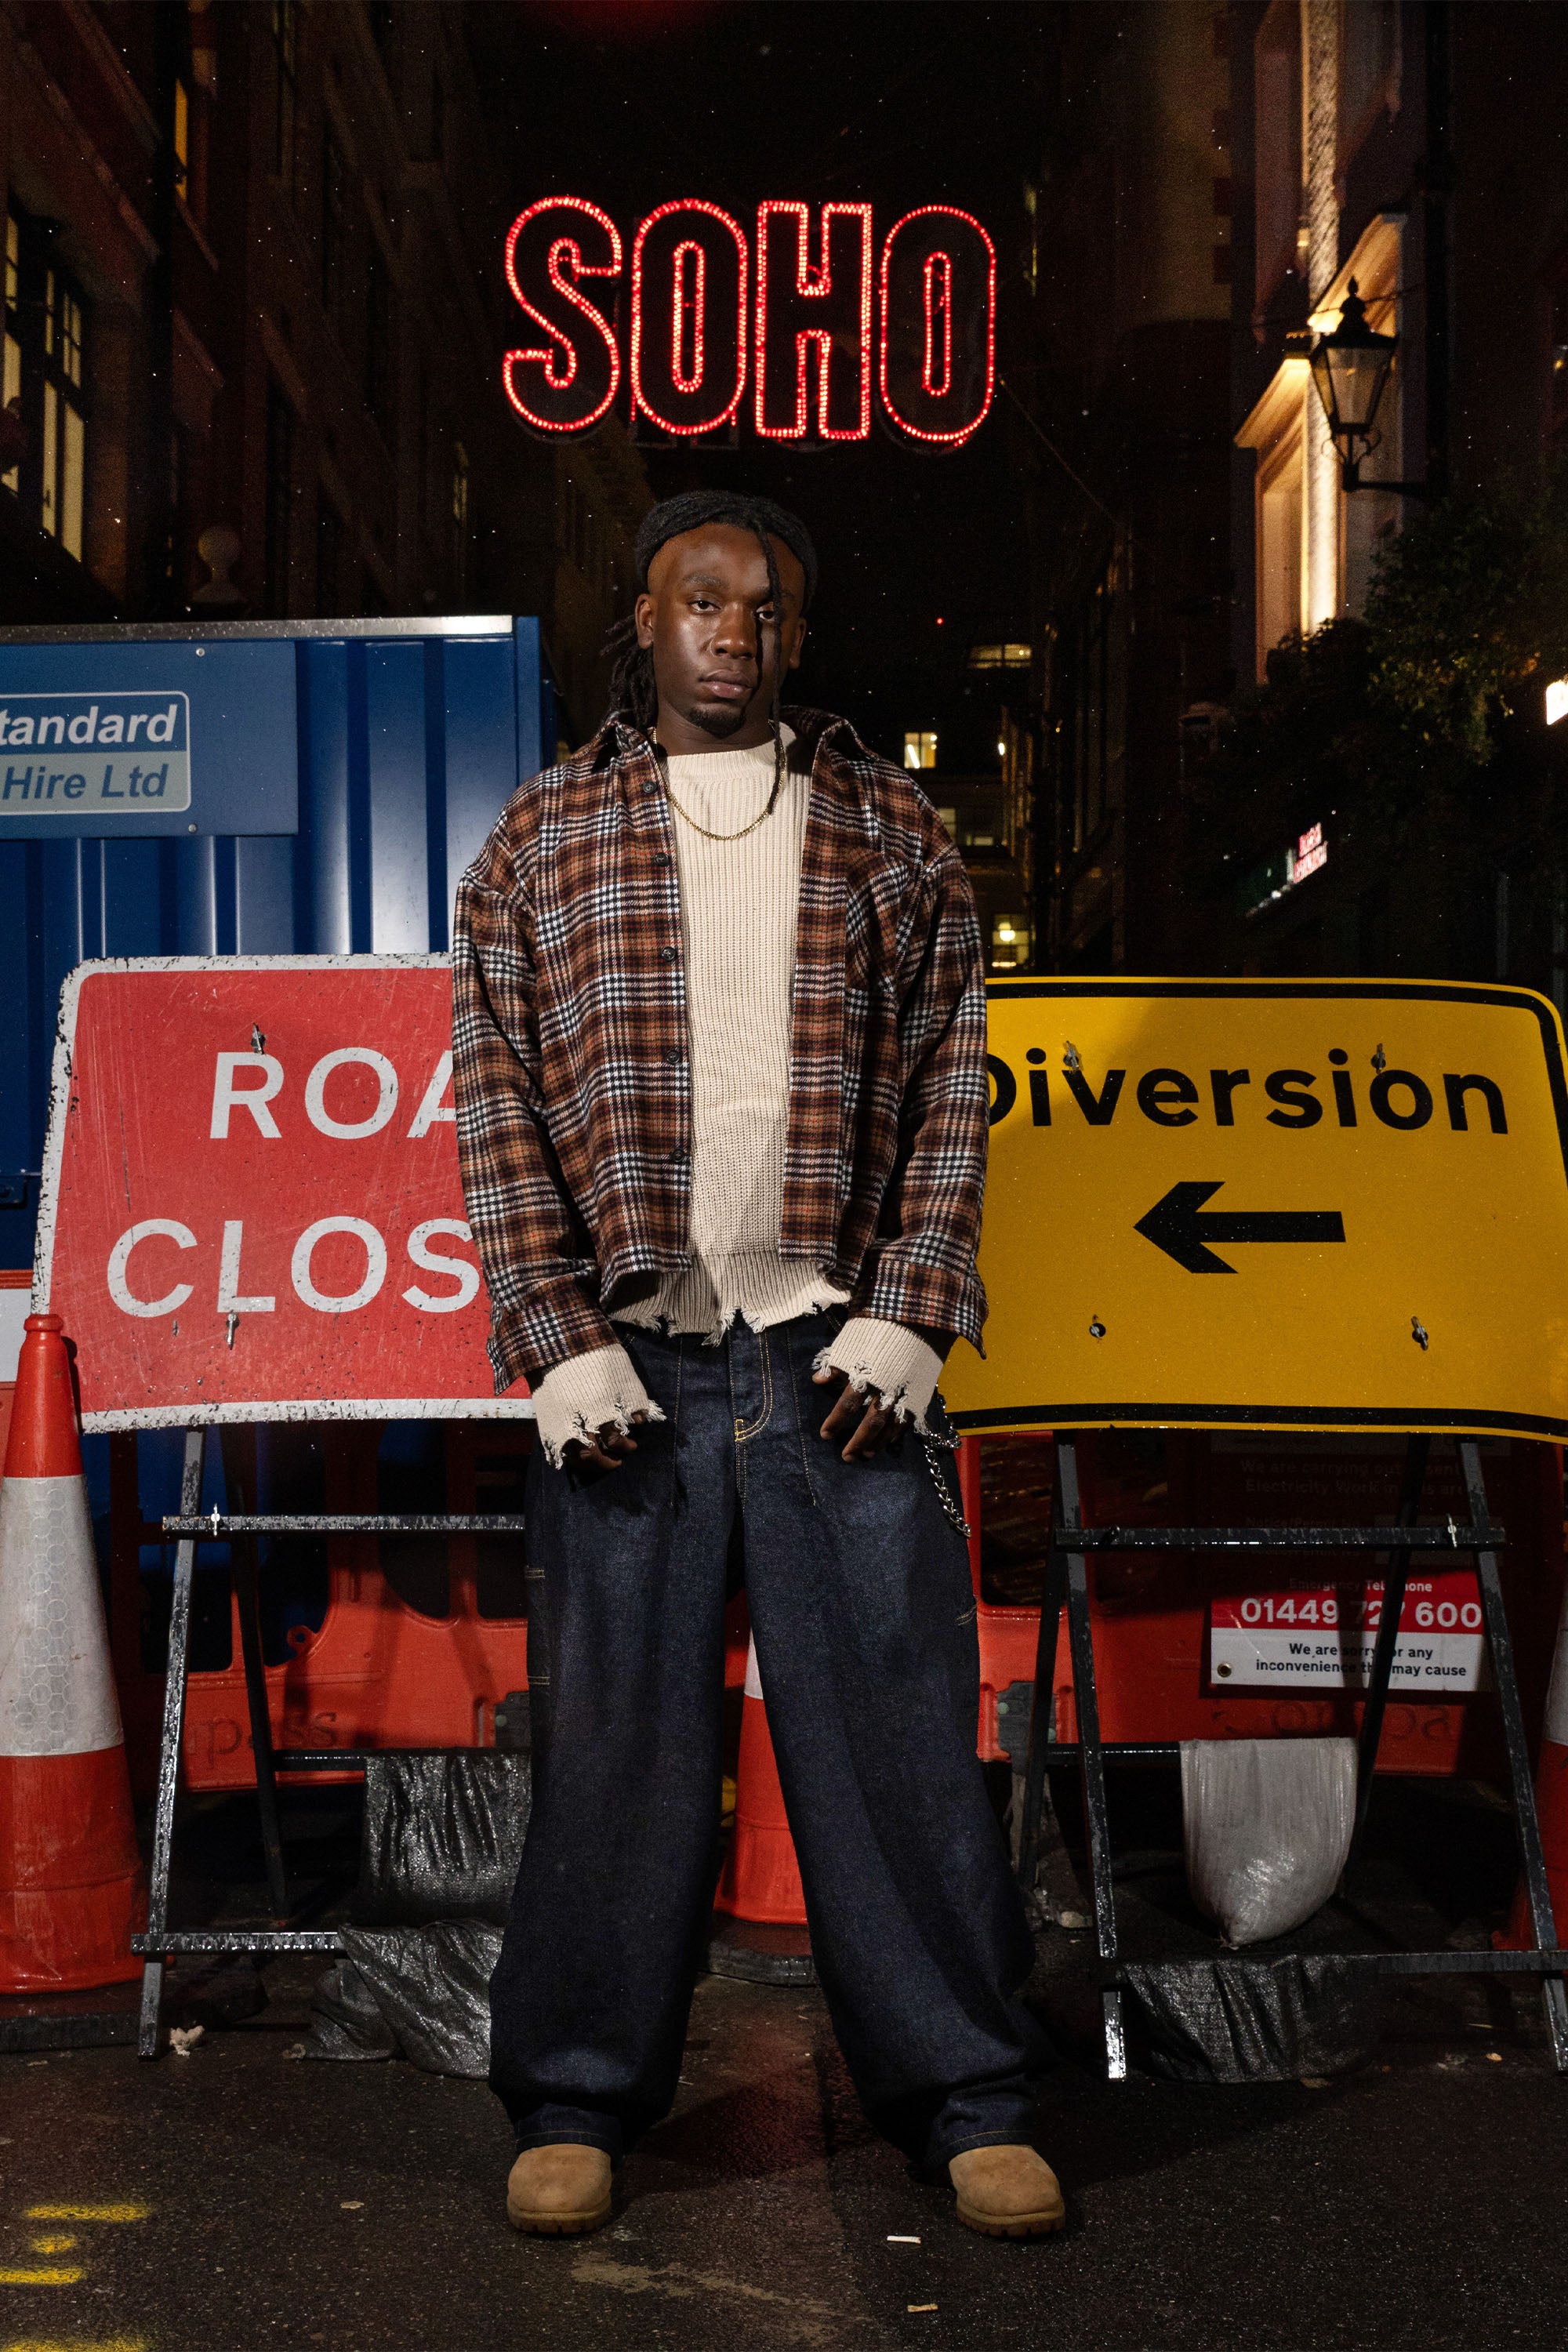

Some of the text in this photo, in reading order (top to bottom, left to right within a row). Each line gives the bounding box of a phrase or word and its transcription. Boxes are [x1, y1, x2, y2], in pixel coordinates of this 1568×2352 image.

[503, 195, 996, 442] SOHO
[0, 704, 177, 745] tandard
[2, 764, 169, 800] Hire Ltd
[210, 1047, 456, 1140] ROA
[107, 1215, 481, 1317] CLOS
[1366, 1580, 1432, 1592] Telone
[1241, 1598, 1482, 1628] 01449 72 600
[1256, 1659, 1356, 1673] inconvenience
[1392, 1664, 1421, 1676] may
[1425, 1666, 1466, 1676] cause
[1290, 1643, 1311, 1655] We
[1316, 1646, 1338, 1656] are
[1408, 1648, 1433, 1660] any
